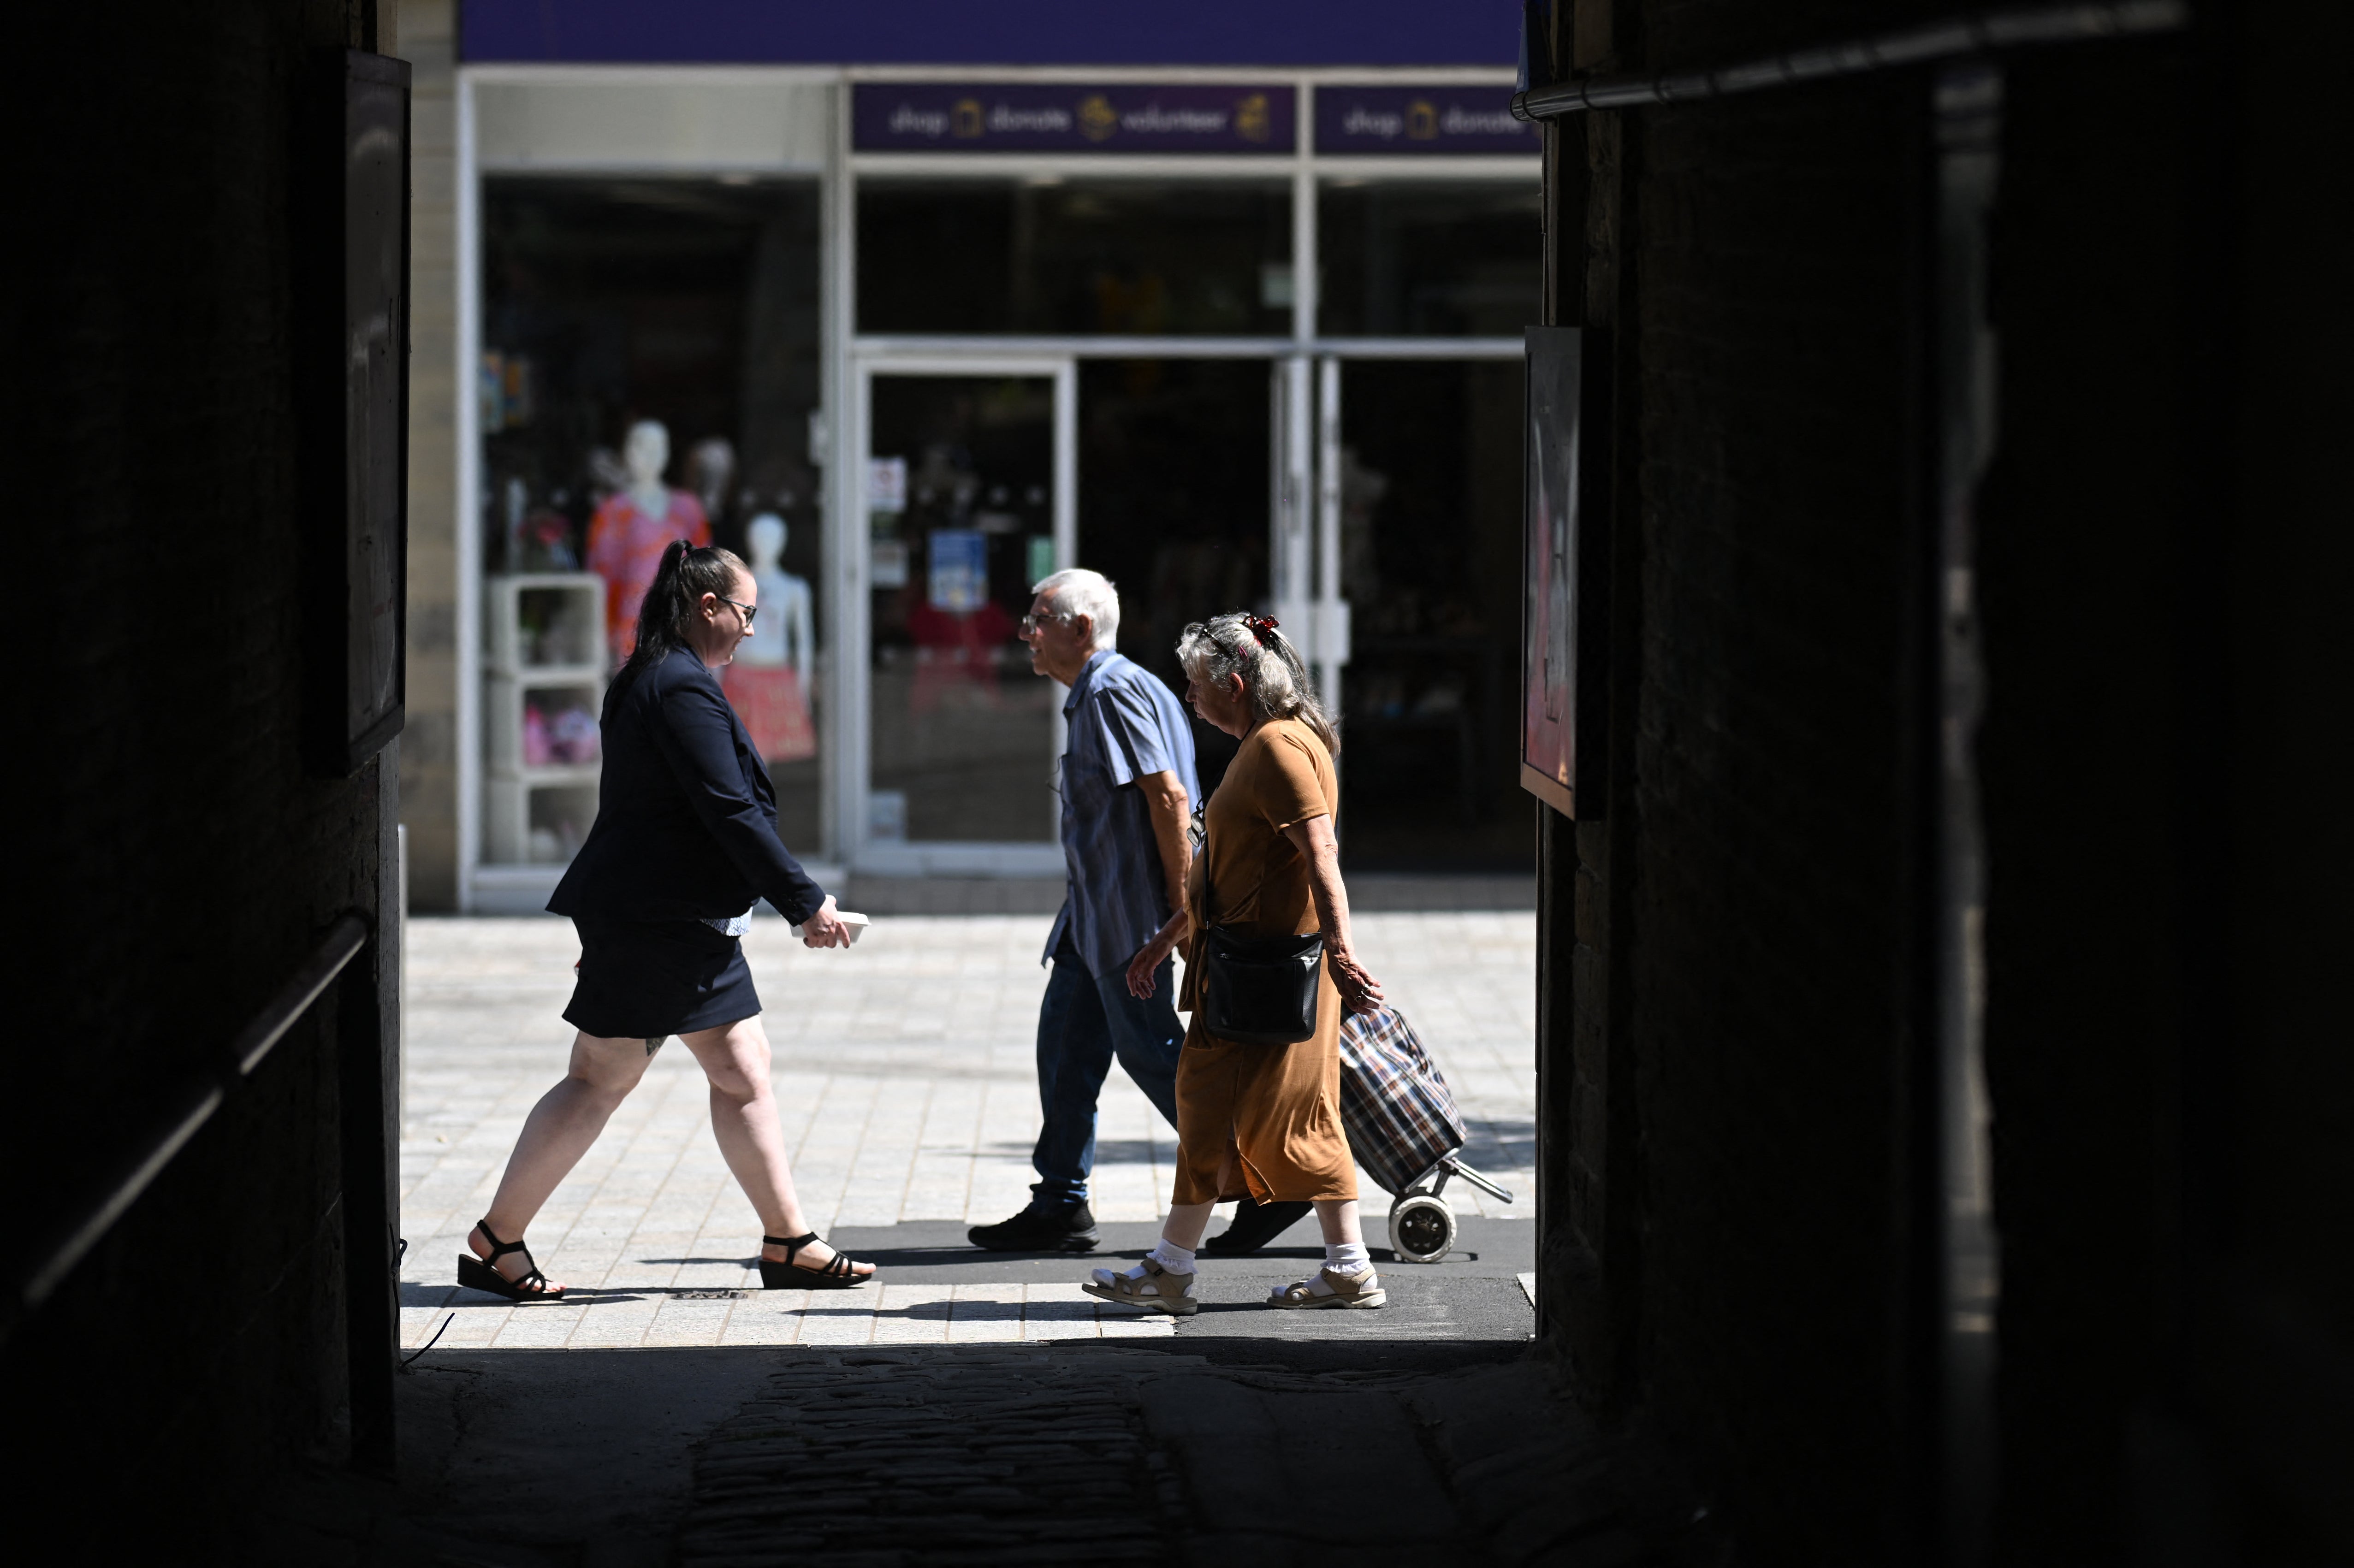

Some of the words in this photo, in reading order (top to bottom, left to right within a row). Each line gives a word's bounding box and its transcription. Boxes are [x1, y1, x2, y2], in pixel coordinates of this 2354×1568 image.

[889, 103, 948, 139] shop
[988, 104, 1073, 132] donate
[1121, 104, 1227, 132] volunteer
[1343, 104, 1401, 140] shop
